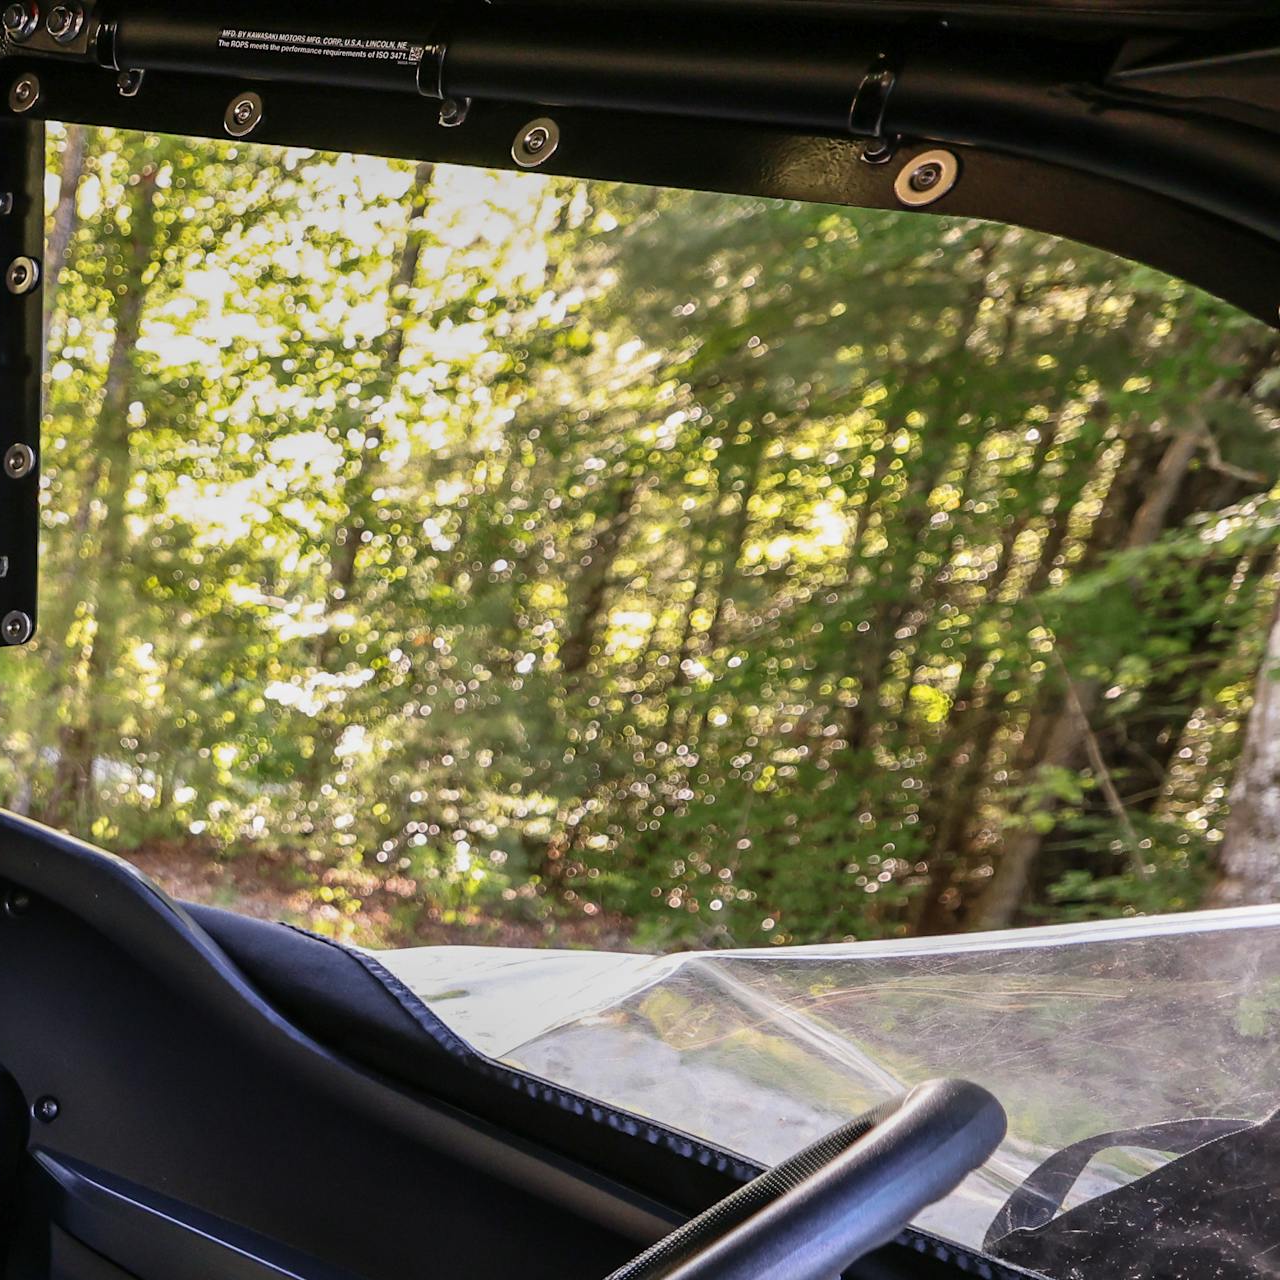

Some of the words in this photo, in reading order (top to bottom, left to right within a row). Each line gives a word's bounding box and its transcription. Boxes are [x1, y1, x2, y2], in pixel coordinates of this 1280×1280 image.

[219, 39, 230, 47] The
[231, 39, 249, 48] ROPS
[250, 42, 269, 50] meets
[270, 43, 280, 51] the
[281, 45, 322, 55] performance
[323, 49, 366, 58] requirements
[368, 50, 376, 58] of
[376, 50, 389, 59] ISO
[390, 51, 408, 60] 3471.
[222, 30, 237, 38] MFD.
[247, 31, 278, 40] KAWASAKI
[279, 34, 306, 43] MOTORS
[306, 36, 321, 44] MFG.
[366, 40, 396, 49] LINCOLN,
